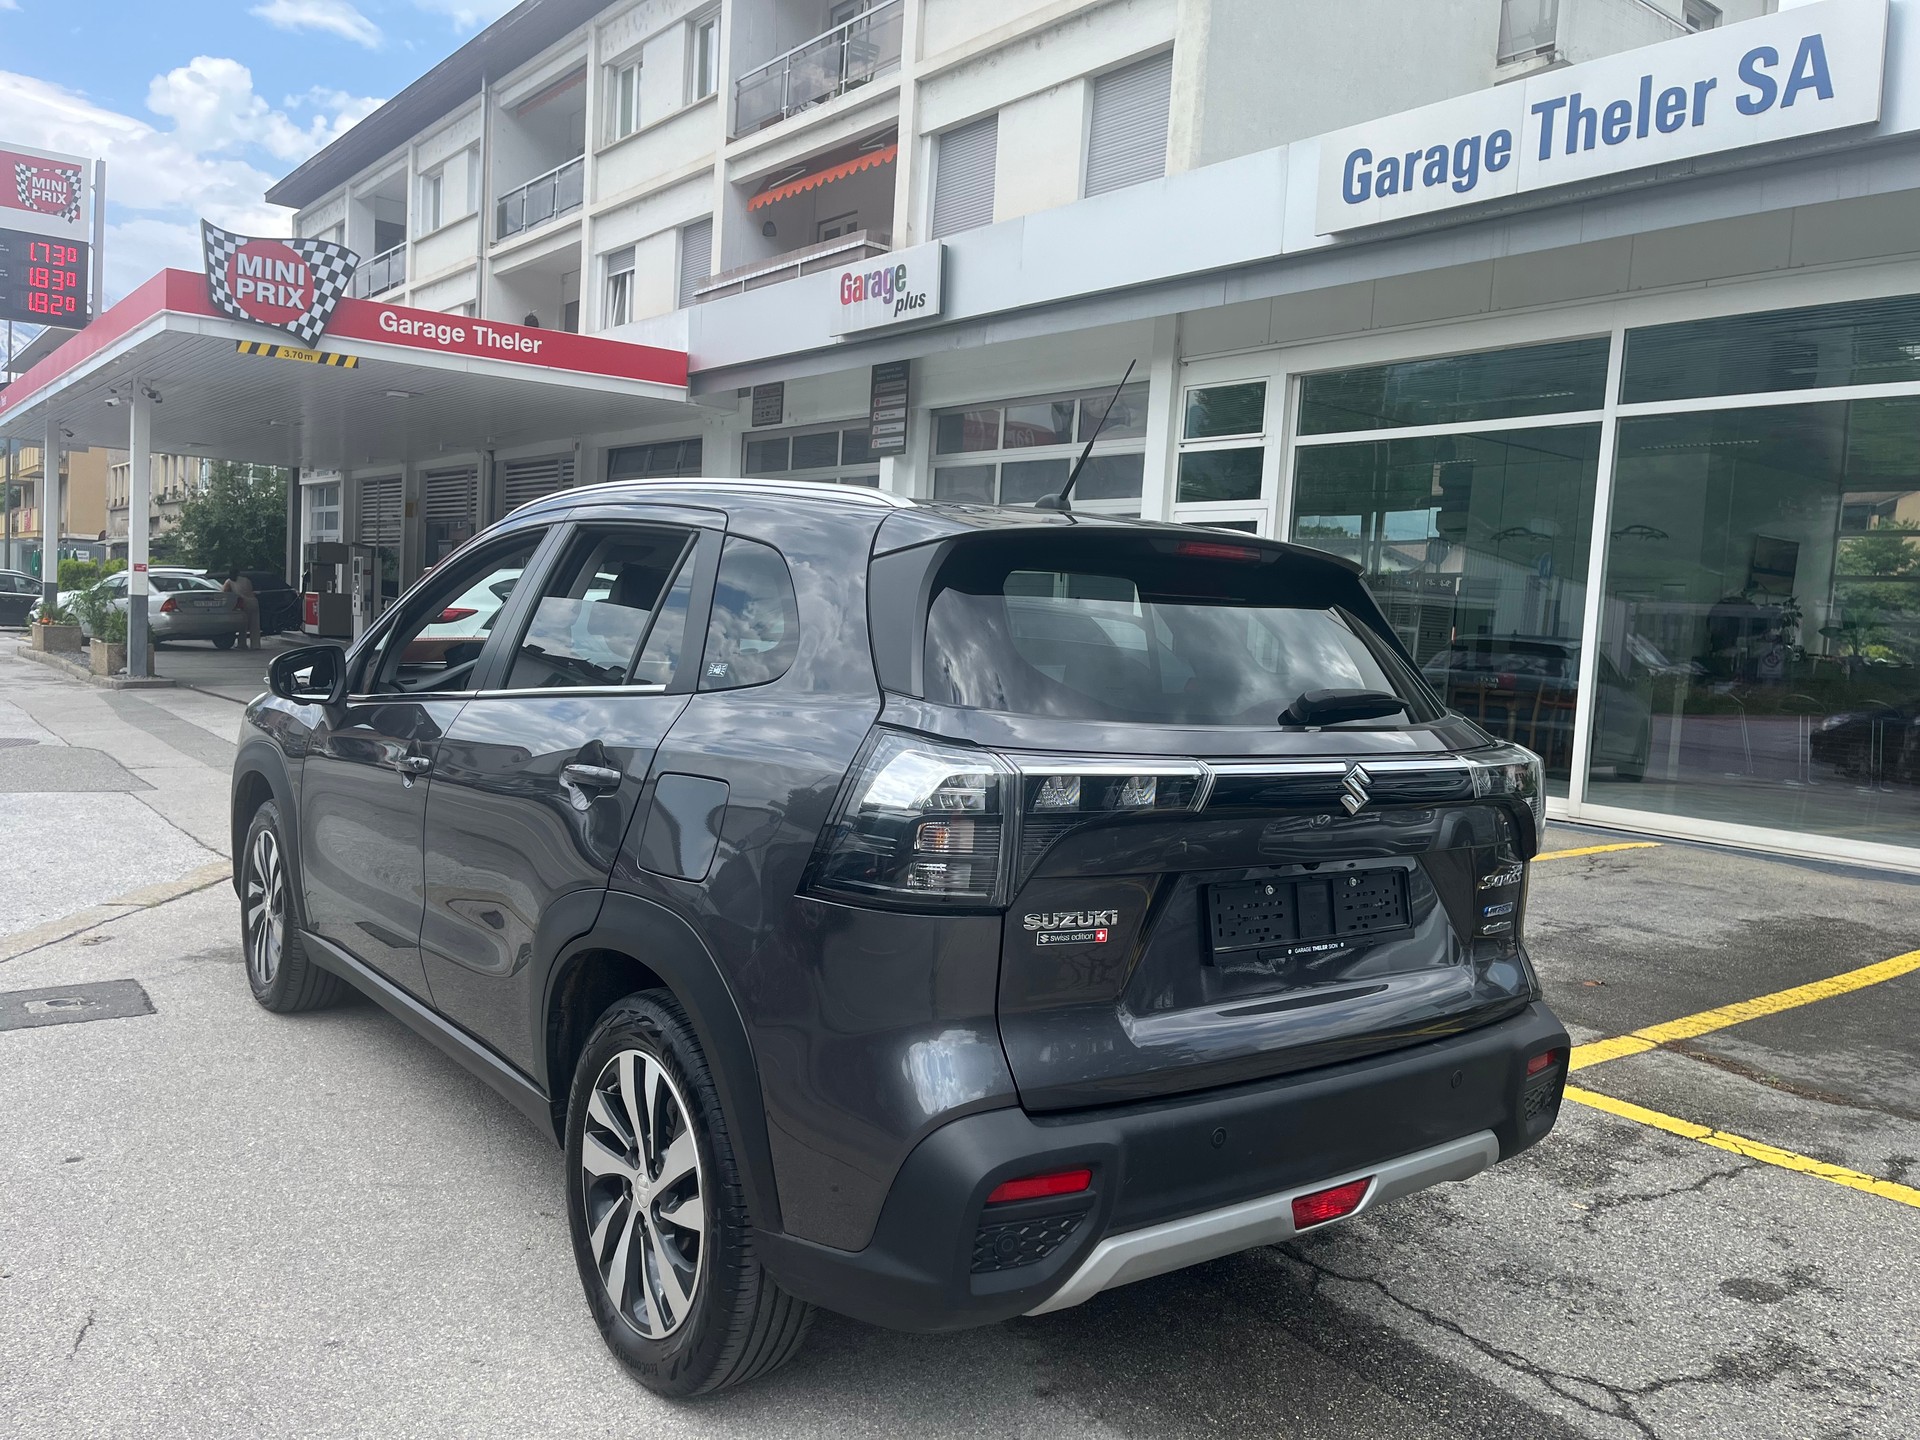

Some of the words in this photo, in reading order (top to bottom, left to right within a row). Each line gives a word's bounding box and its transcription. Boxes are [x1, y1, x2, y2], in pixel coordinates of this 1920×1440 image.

[1342, 128, 1513, 204] Garage
[1530, 74, 1717, 161] Theler
[1735, 33, 1834, 116] SA
[31, 188, 67, 205] PRIX
[32, 176, 67, 193] MINI
[237, 253, 305, 286] MINI
[840, 263, 907, 305] Garage
[236, 278, 305, 310] PRIX
[893, 291, 926, 318] plus
[379, 311, 466, 345] Garage
[472, 325, 543, 354] Theler
[1023, 909, 1118, 931] SUZUKI
[1071, 932, 1094, 941] edition
